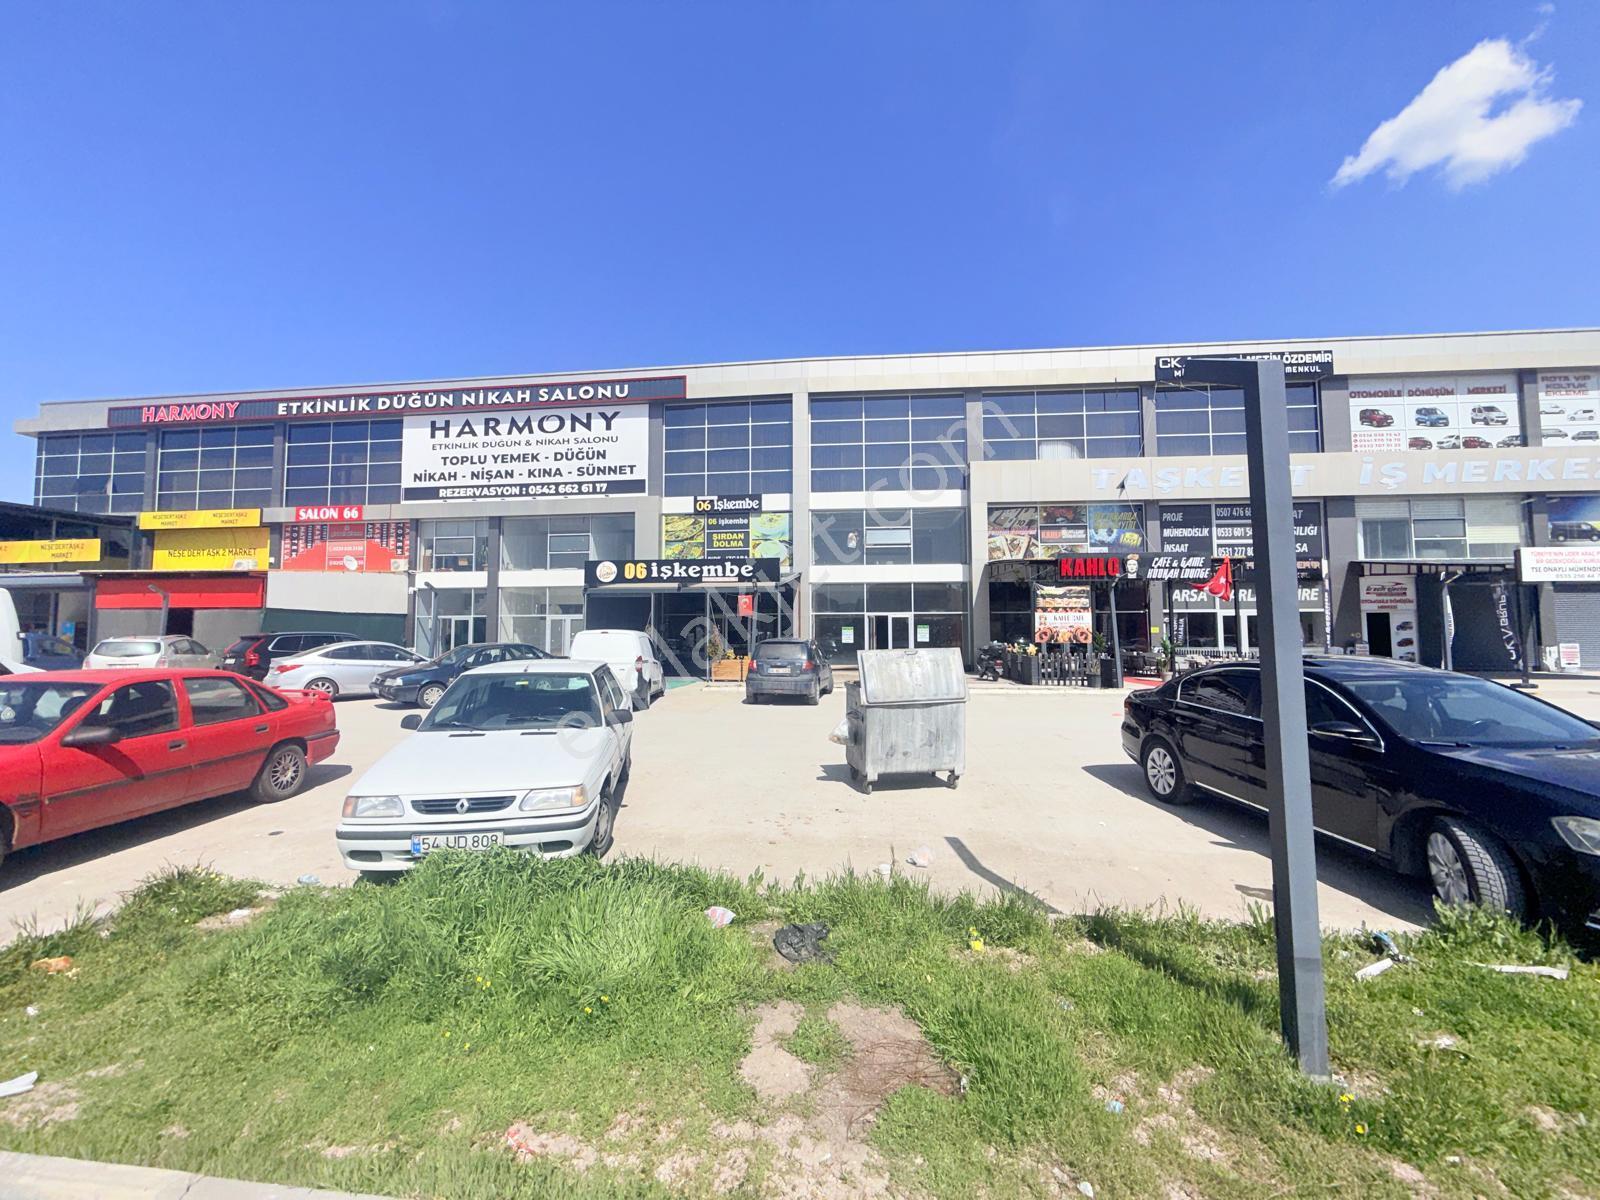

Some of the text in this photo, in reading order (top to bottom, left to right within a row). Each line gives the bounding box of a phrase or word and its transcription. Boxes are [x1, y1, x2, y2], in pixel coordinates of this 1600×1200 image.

[1282, 351, 1332, 364] ÖZDEMİR
[141, 384, 629, 423] HARMONY ETKİNLİK DÜĞÜN NİKAH SALONU
[430, 411, 621, 439] HARMONY
[524, 439, 532, 447] &
[573, 435, 619, 444] SALONU
[441, 454, 487, 466] TOPLU
[491, 452, 541, 464] YEMEK
[553, 447, 607, 462] DÜĞÜN
[413, 469, 457, 483] NİKAH
[470, 467, 514, 483] NİŞAN
[527, 467, 563, 479] KINA
[576, 463, 637, 477] SÜNNET
[1091, 456, 1600, 493] TAŞKET İŞ MERKE
[439, 485, 520, 498] REZERVASYON
[528, 484, 555, 495] 0542
[558, 483, 578, 494] 662
[581, 483, 593, 493] 61
[595, 482, 607, 492] 17
[696, 500, 712, 511] 06
[299, 507, 359, 520] SALON 66
[1162, 512, 1183, 522] PROJE
[1216, 507, 1231, 517] 0507
[1163, 525, 1209, 537] MÜHENDİSLİK
[1217, 527, 1232, 537] 0533
[713, 540, 744, 548] DOLMA
[228, 547, 257, 557] MARKET
[624, 562, 648, 580] 06
[651, 561, 754, 580] işkembe
[1060, 556, 1120, 577] KAHLO
[1151, 556, 1172, 569] CAFE
[1180, 556, 1206, 569] GAME
[1180, 567, 1211, 579] LOUNGE
[1172, 589, 1208, 602] ARSA
[422, 837, 440, 850] 54
[446, 835, 467, 849] UD
